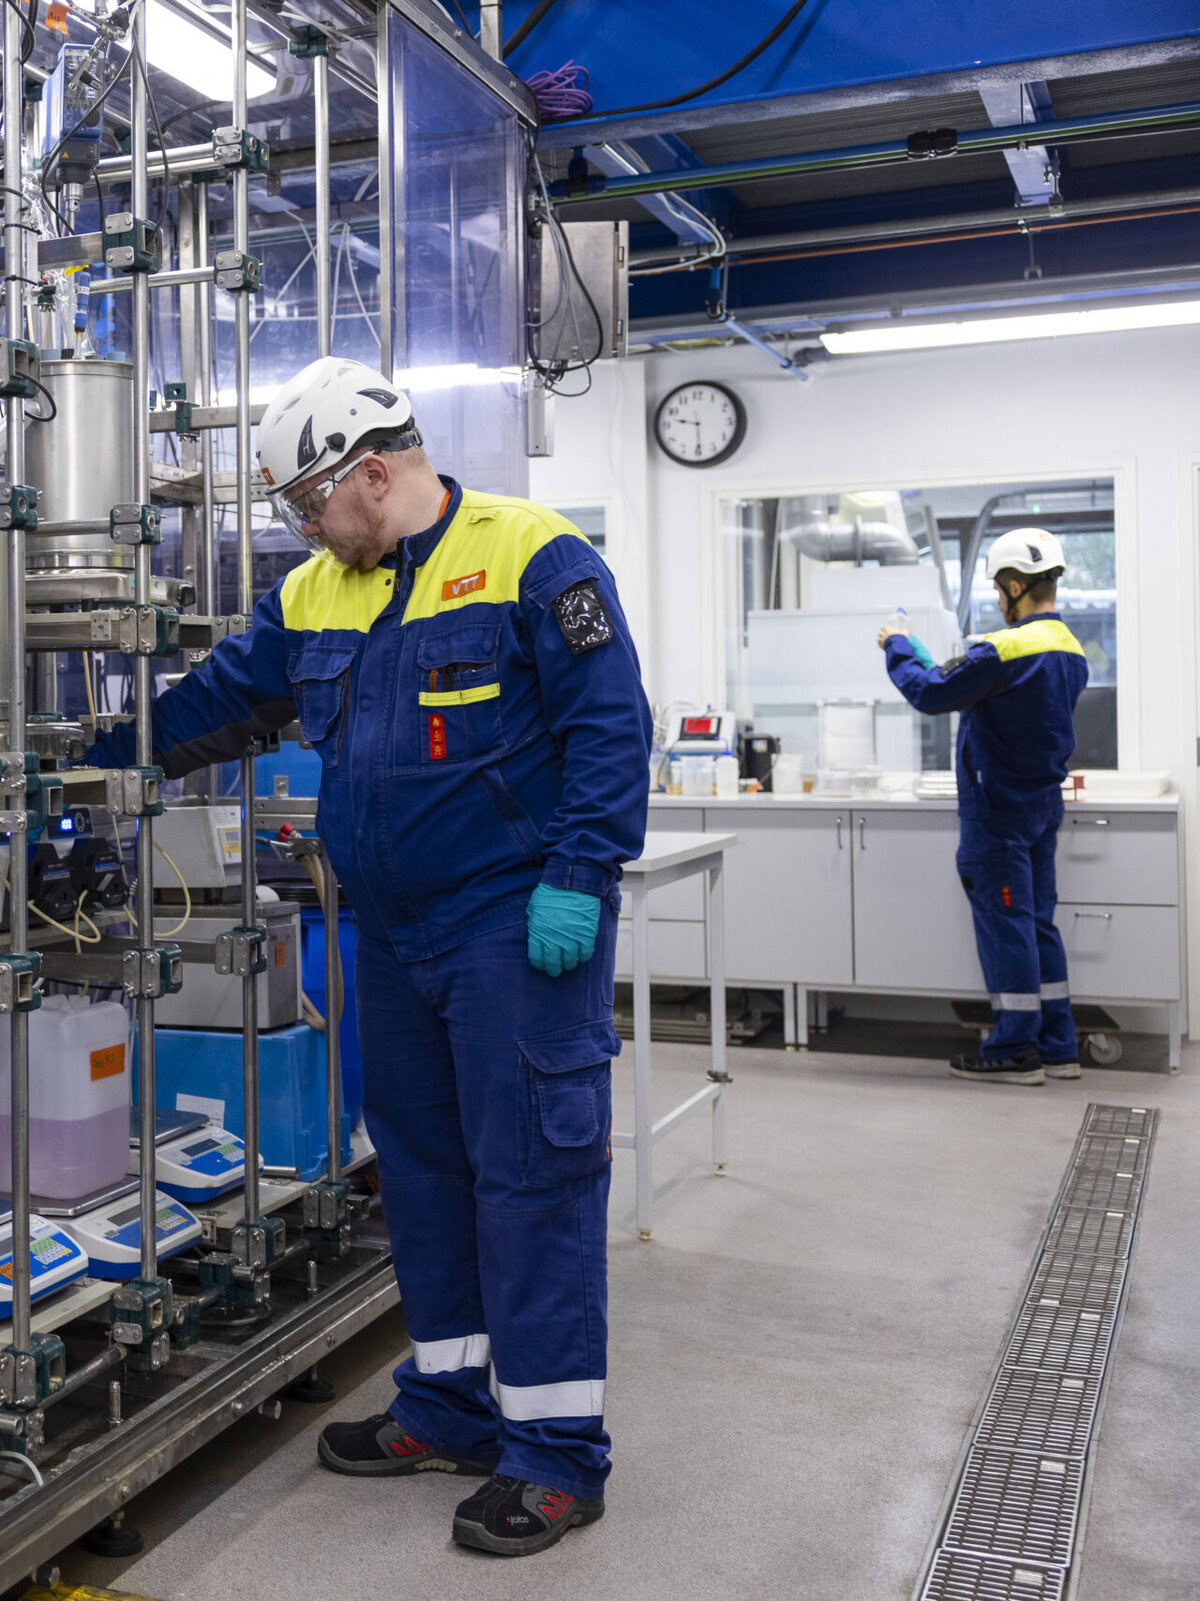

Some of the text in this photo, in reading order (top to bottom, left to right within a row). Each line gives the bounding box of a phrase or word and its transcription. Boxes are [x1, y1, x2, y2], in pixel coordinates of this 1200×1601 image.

[693, 390, 703, 400] 12
[679, 396, 688, 405] 11
[451, 574, 480, 595] VTT
